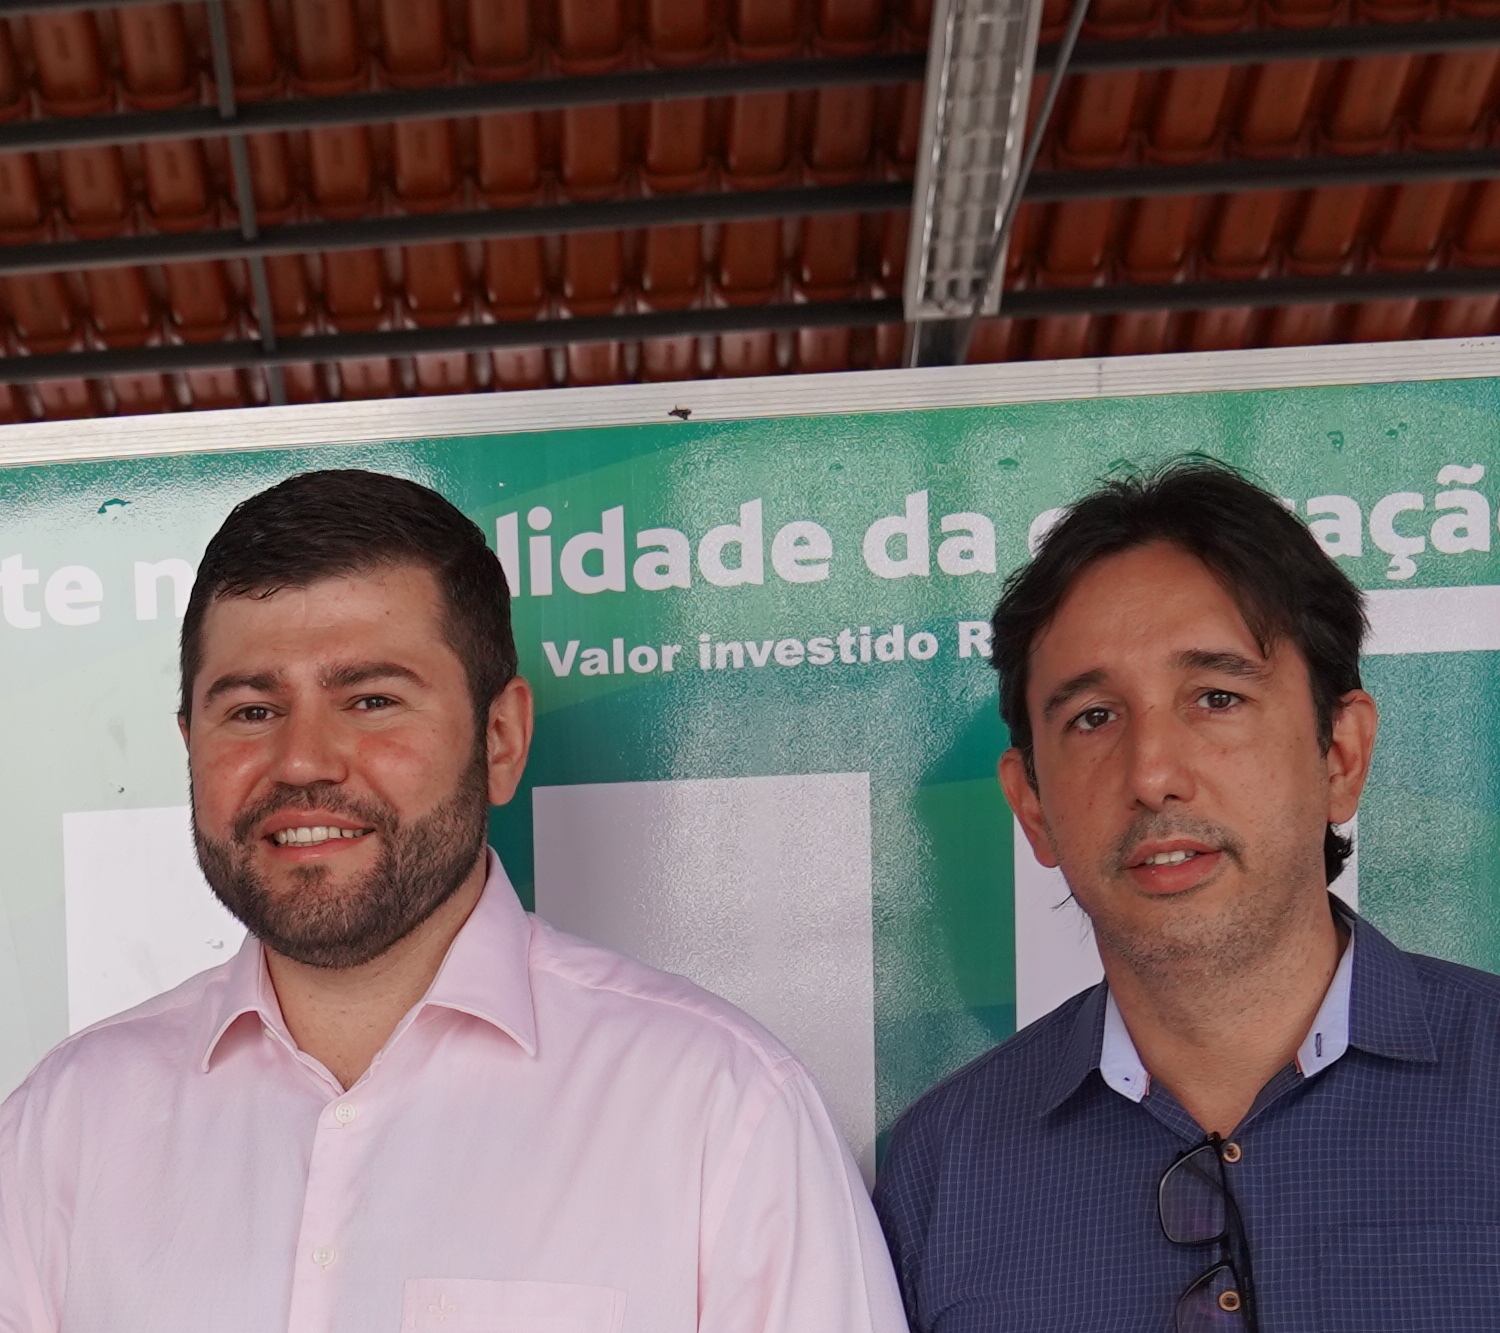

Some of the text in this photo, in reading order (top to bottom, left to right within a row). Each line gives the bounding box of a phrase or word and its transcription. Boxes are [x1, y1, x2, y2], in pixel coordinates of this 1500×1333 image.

[134, 557, 197, 621] n
[495, 498, 833, 598] lidade
[862, 489, 997, 580] da
[543, 638, 681, 678] Valor
[699, 624, 938, 671] investido
